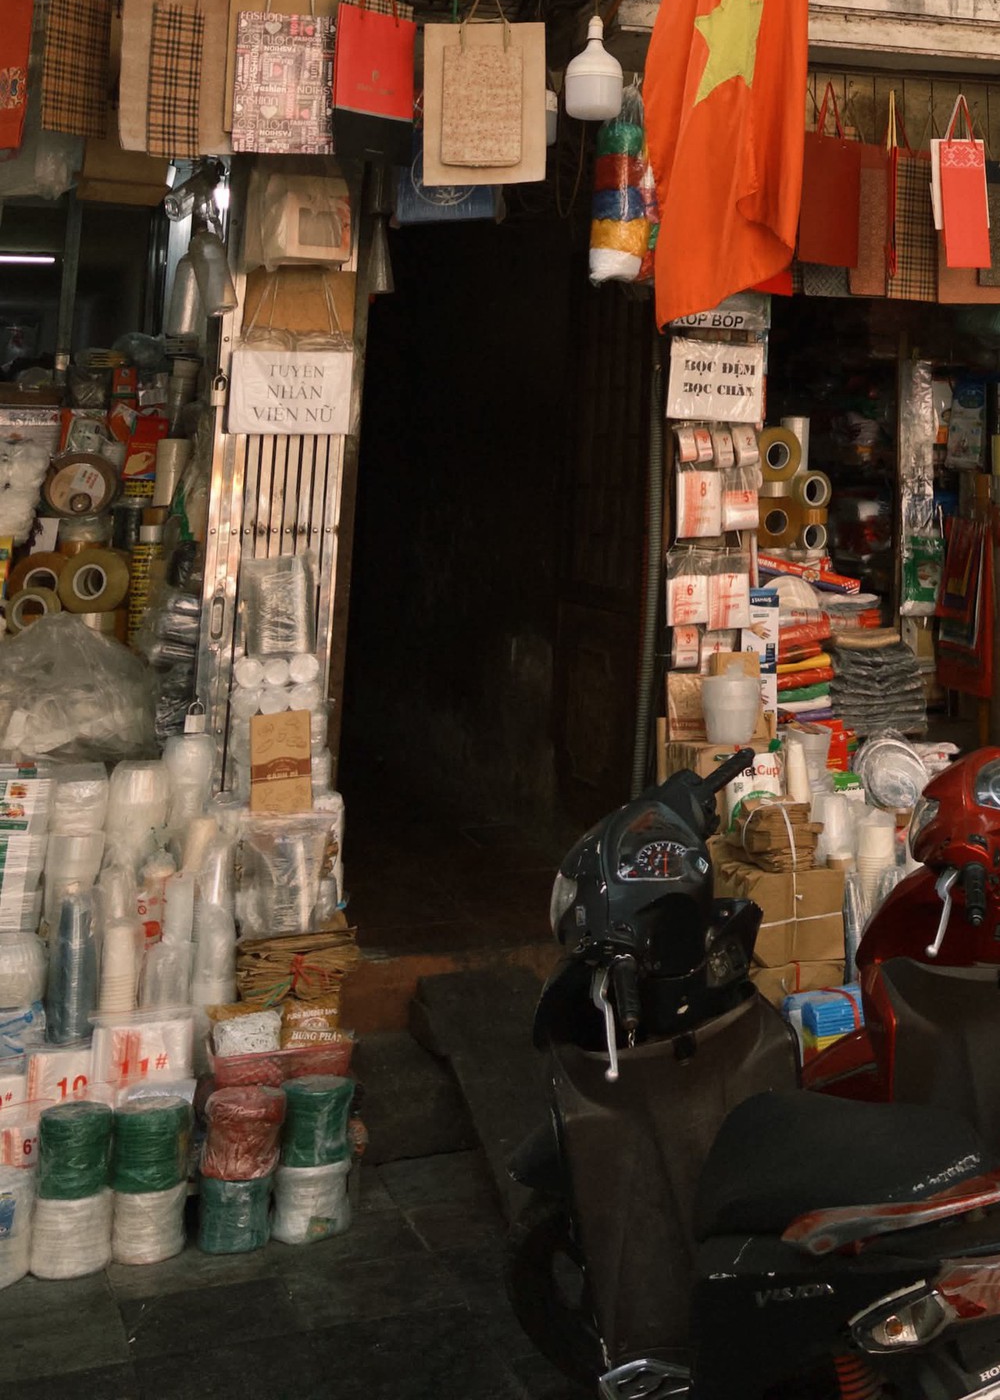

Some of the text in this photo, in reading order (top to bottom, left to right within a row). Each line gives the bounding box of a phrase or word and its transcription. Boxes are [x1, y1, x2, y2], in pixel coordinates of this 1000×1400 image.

[711, 311, 744, 328] BÓP
[684, 358, 756, 379] BỌC ĐỆM
[683, 382, 713, 397] BỌC
